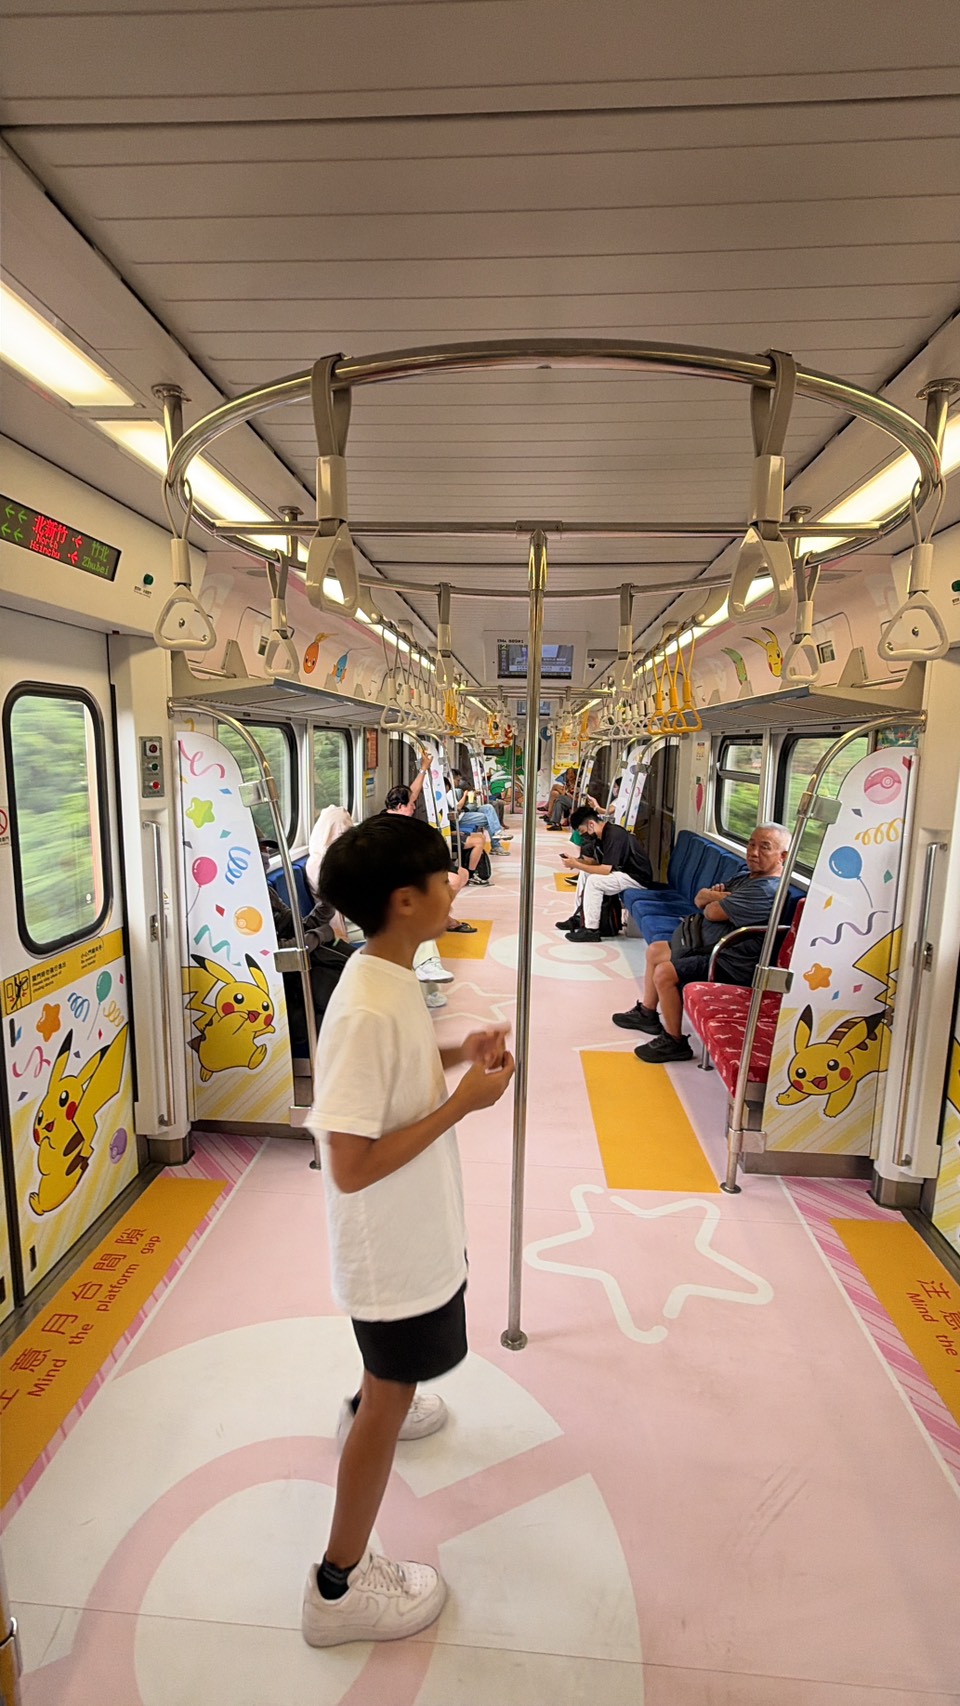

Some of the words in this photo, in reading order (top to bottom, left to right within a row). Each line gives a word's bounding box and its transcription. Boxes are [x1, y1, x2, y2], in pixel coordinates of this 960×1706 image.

[32, 515, 68, 544] 北新竹
[29, 540, 61, 560] Hsinchu
[36, 534, 59, 550] North
[91, 541, 110, 562] 竹北
[82, 556, 110, 575] Zhubei
[27, 1358, 67, 1397] Mind
[68, 1323, 94, 1345] the
[96, 1263, 140, 1312] platform
[140, 1235, 161, 1255] gap
[906, 1292, 940, 1322] Mind
[936, 1335, 958, 1356] the
